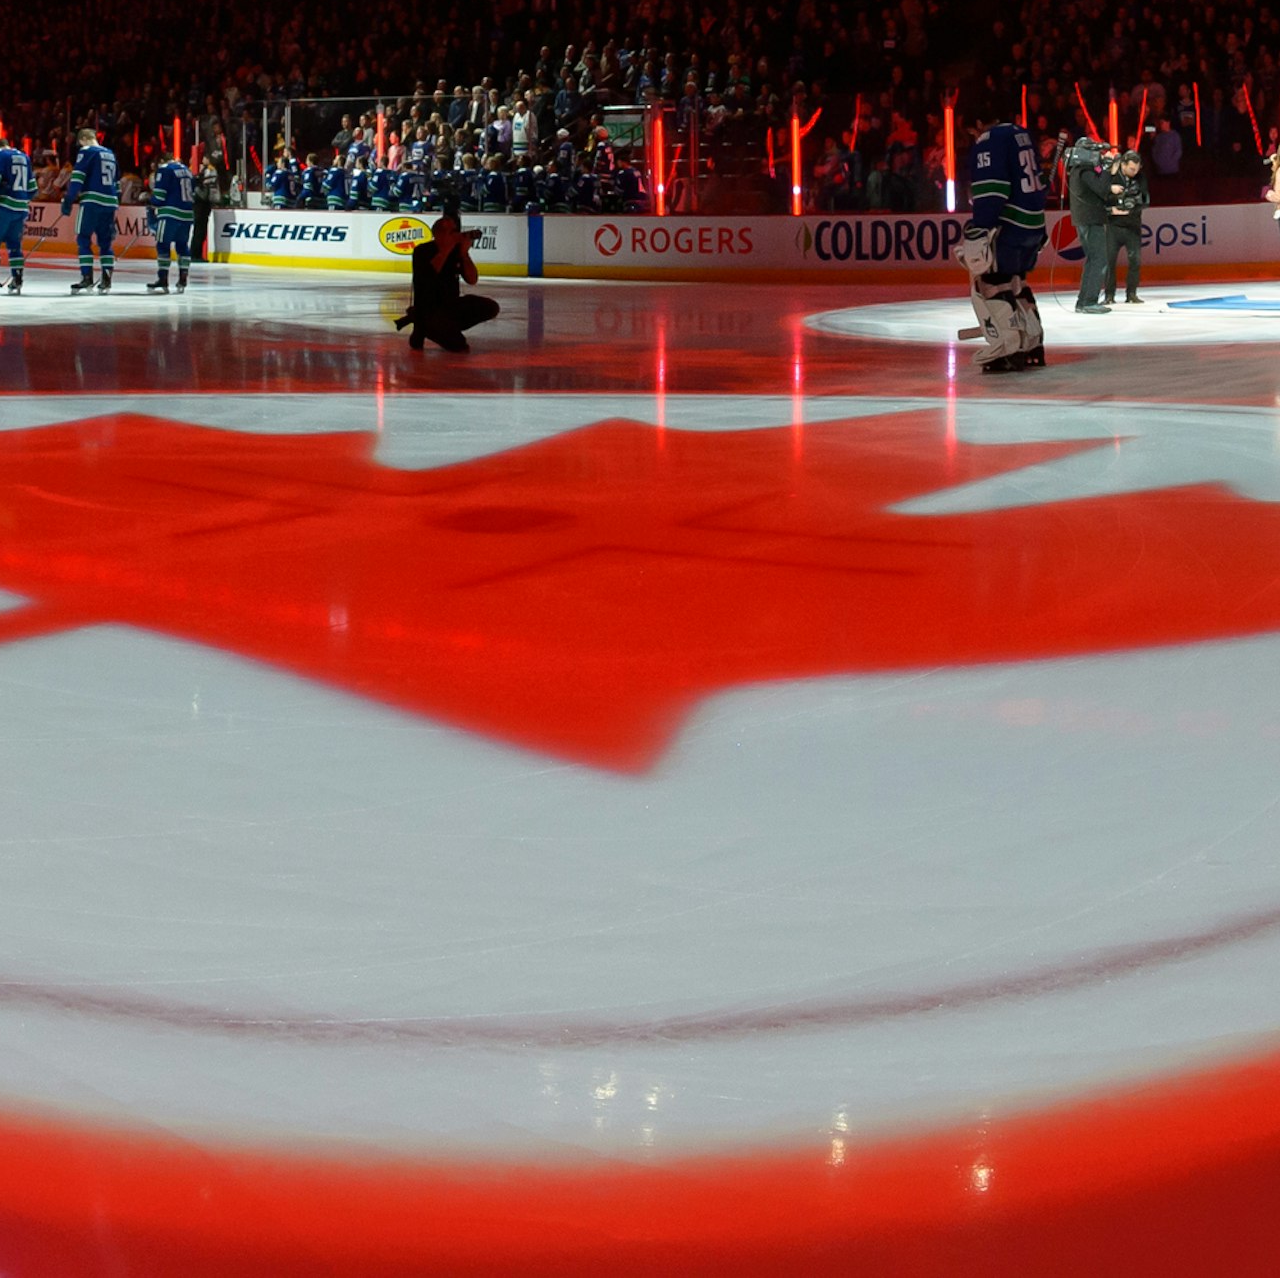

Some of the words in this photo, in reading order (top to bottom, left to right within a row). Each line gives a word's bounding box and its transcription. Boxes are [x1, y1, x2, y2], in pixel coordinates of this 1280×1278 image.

[977, 151, 991, 169] 35
[221, 223, 349, 241] SKECHERS
[385, 227, 426, 243] PENNZOIL
[631, 228, 753, 255] ROGERS
[815, 220, 966, 261] COLDROP
[1140, 216, 1207, 254] epsi
